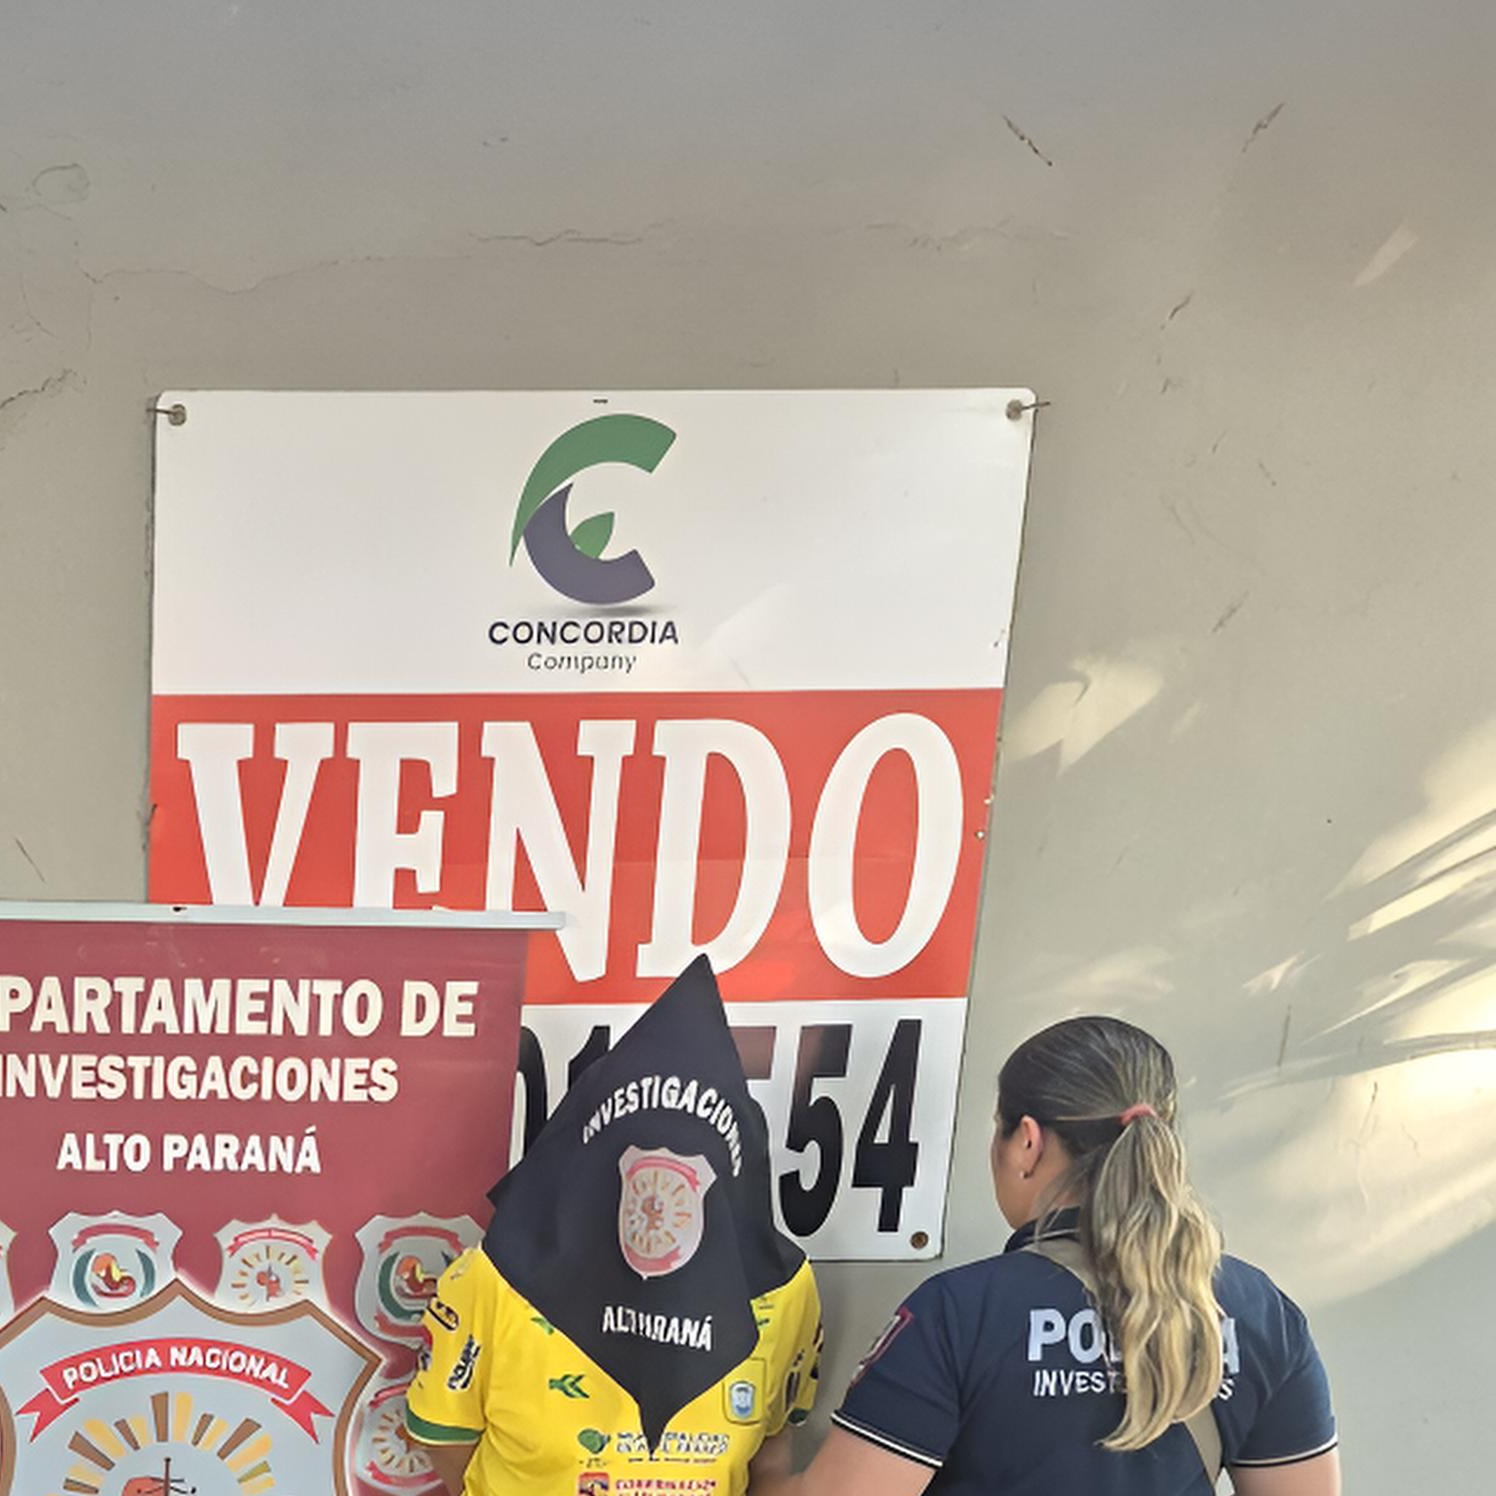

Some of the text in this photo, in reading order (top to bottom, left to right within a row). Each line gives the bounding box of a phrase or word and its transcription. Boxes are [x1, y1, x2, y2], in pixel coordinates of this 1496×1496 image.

[488, 620, 679, 645] CONCORDIA
[527, 652, 637, 674] Company
[177, 712, 964, 983] VENDO
[401, 980, 479, 1038] DE
[56, 1126, 321, 1175] ALTO PARANÁ
[62, 1345, 290, 1389] POLICIA NACIONAL
